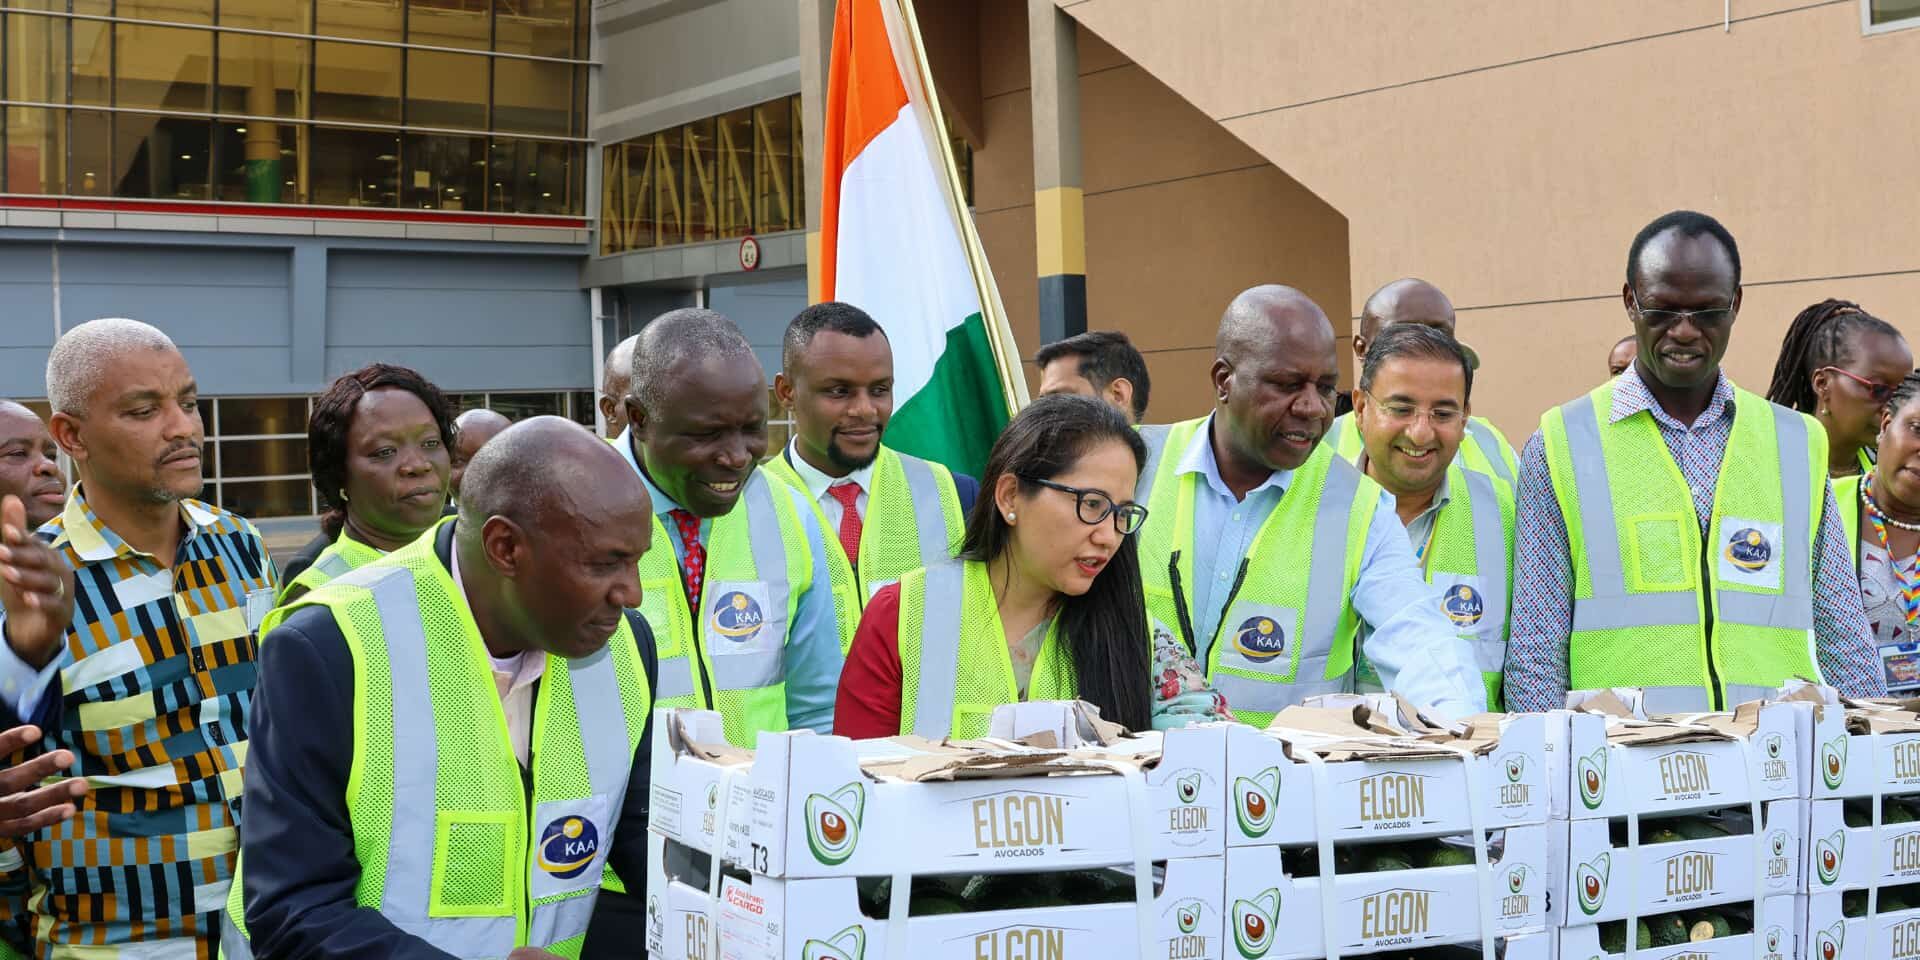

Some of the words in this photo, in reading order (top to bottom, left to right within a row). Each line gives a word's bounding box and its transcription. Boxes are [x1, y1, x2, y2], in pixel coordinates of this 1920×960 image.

[1747, 546, 1767, 560] KAA
[1460, 602, 1481, 611] KAA
[735, 611, 761, 623] KAA
[1256, 636, 1281, 648] KAA
[1660, 754, 1711, 794] ELGON
[1764, 760, 1787, 778] ELGON
[1360, 775, 1424, 820] ELGON
[1500, 783, 1528, 804] ELGON
[1674, 793, 1701, 801] AVOCADOS
[972, 795, 1064, 849] ELGON
[1170, 807, 1207, 830] ELGON
[1374, 821, 1411, 830] AVOCADOS
[565, 839, 595, 856] KAA
[994, 847, 1045, 858] AVOCADOS
[751, 842, 768, 874] T3
[1768, 857, 1788, 876] ELGON
[1666, 854, 1714, 896] ELGON
[733, 896, 763, 915] CARGO
[1502, 894, 1528, 915] ELGON
[1675, 893, 1702, 902] AVOCADOS
[1362, 892, 1428, 938] ELGON
[975, 928, 1064, 960] ELGON
[1169, 936, 1206, 959] ELGON
[1375, 936, 1412, 946] AVOCADOS
